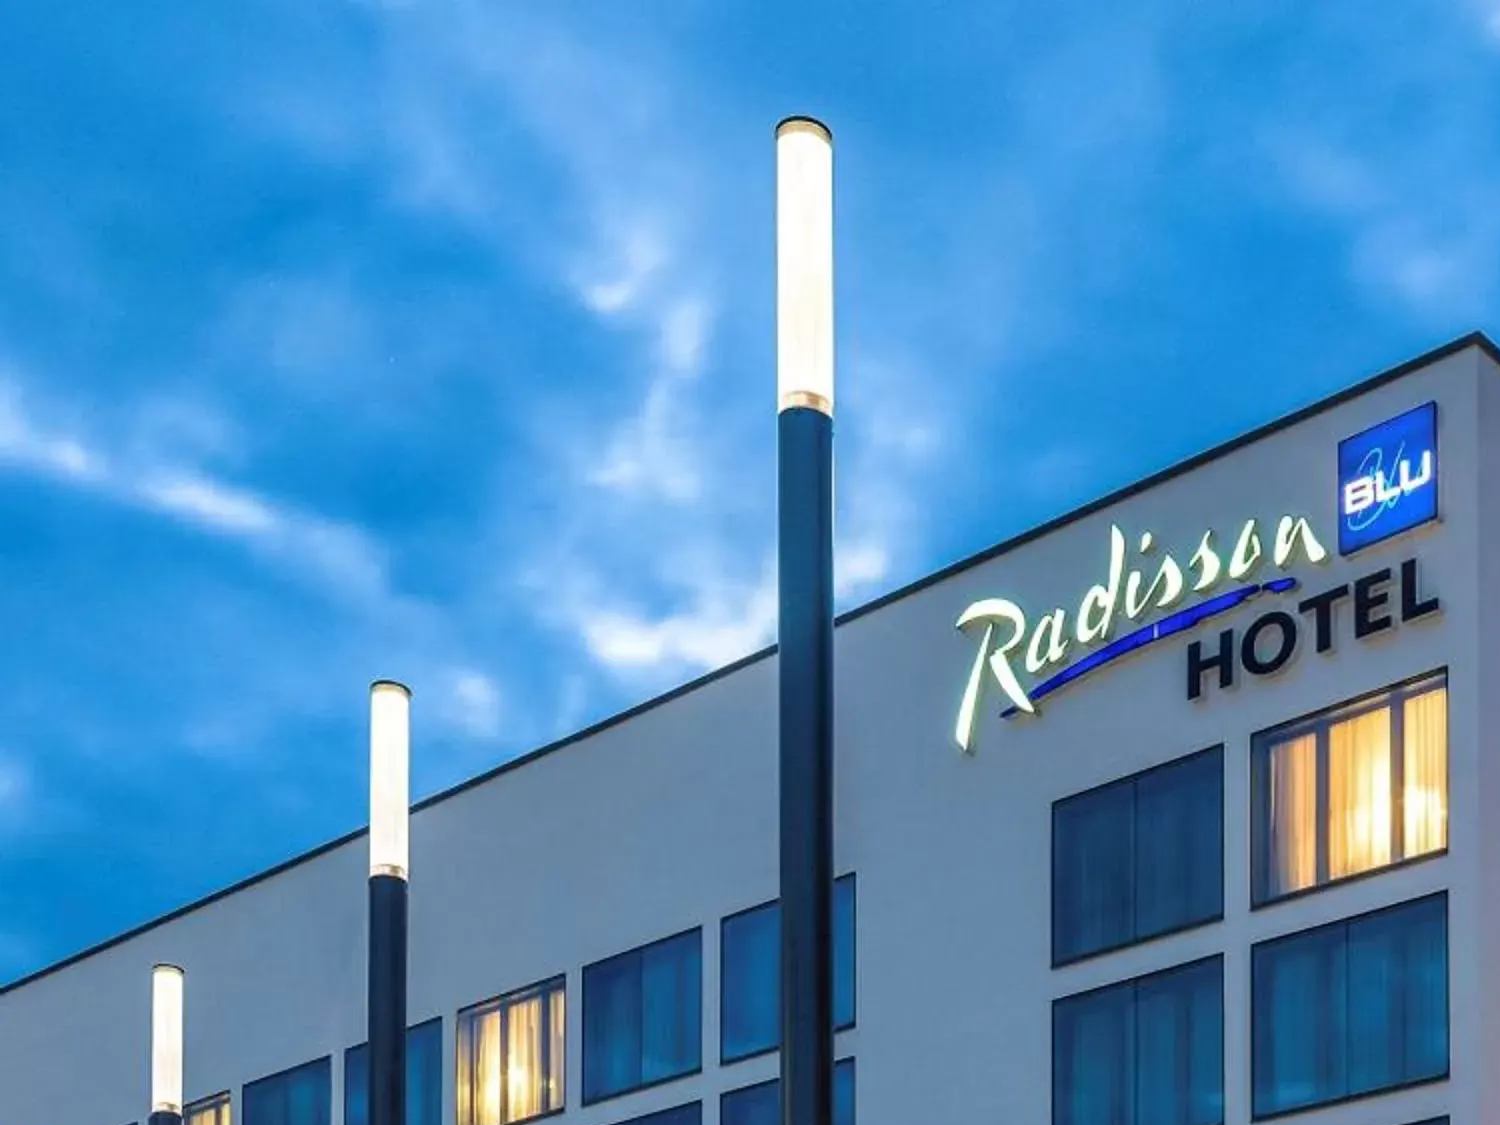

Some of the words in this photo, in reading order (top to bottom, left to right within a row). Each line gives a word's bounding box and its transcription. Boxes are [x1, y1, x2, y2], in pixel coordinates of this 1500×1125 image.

[1344, 449, 1432, 515] BLU
[956, 514, 1327, 753] Radisson
[1187, 557, 1440, 702] HOTEL
